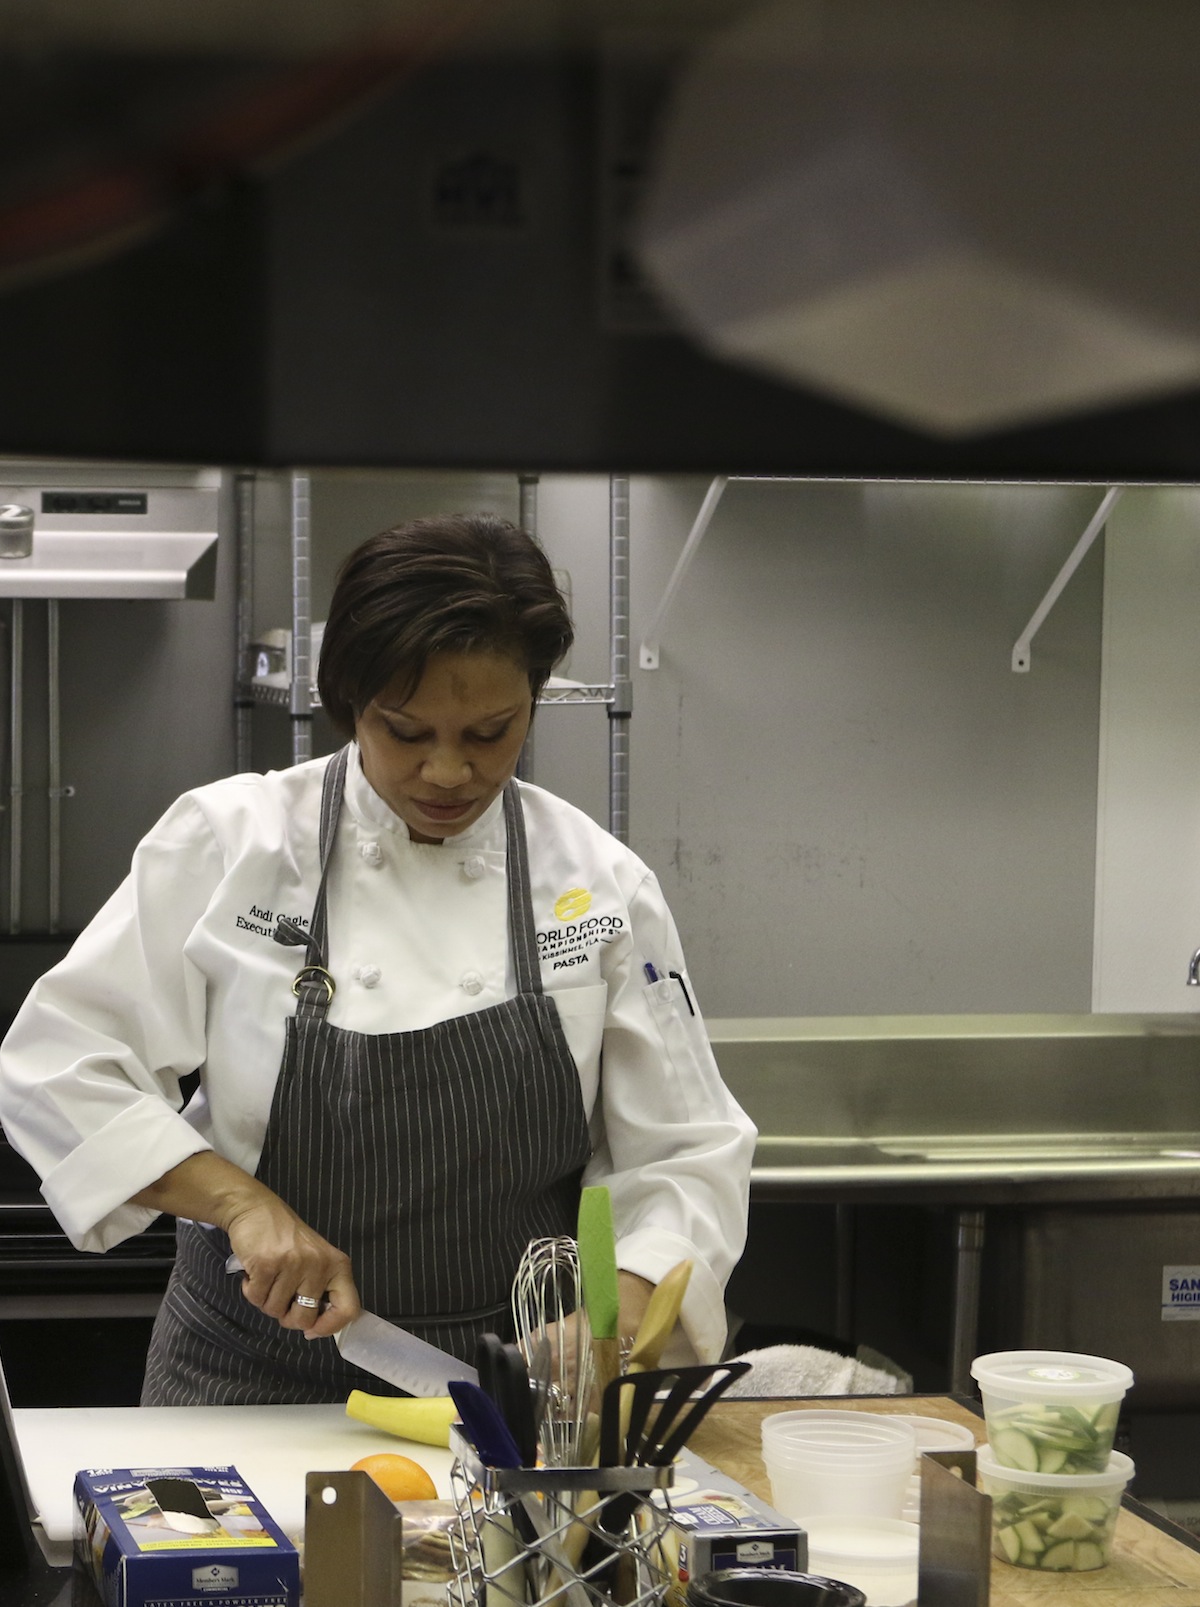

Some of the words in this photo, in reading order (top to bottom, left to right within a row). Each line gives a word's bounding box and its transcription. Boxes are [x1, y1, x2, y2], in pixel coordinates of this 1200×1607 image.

[249, 905, 273, 922] Andi
[536, 925, 576, 945] ORLD
[580, 916, 623, 933] FOOD
[538, 928, 614, 953] AMPIONSHIPS
[553, 954, 589, 970] PASTA
